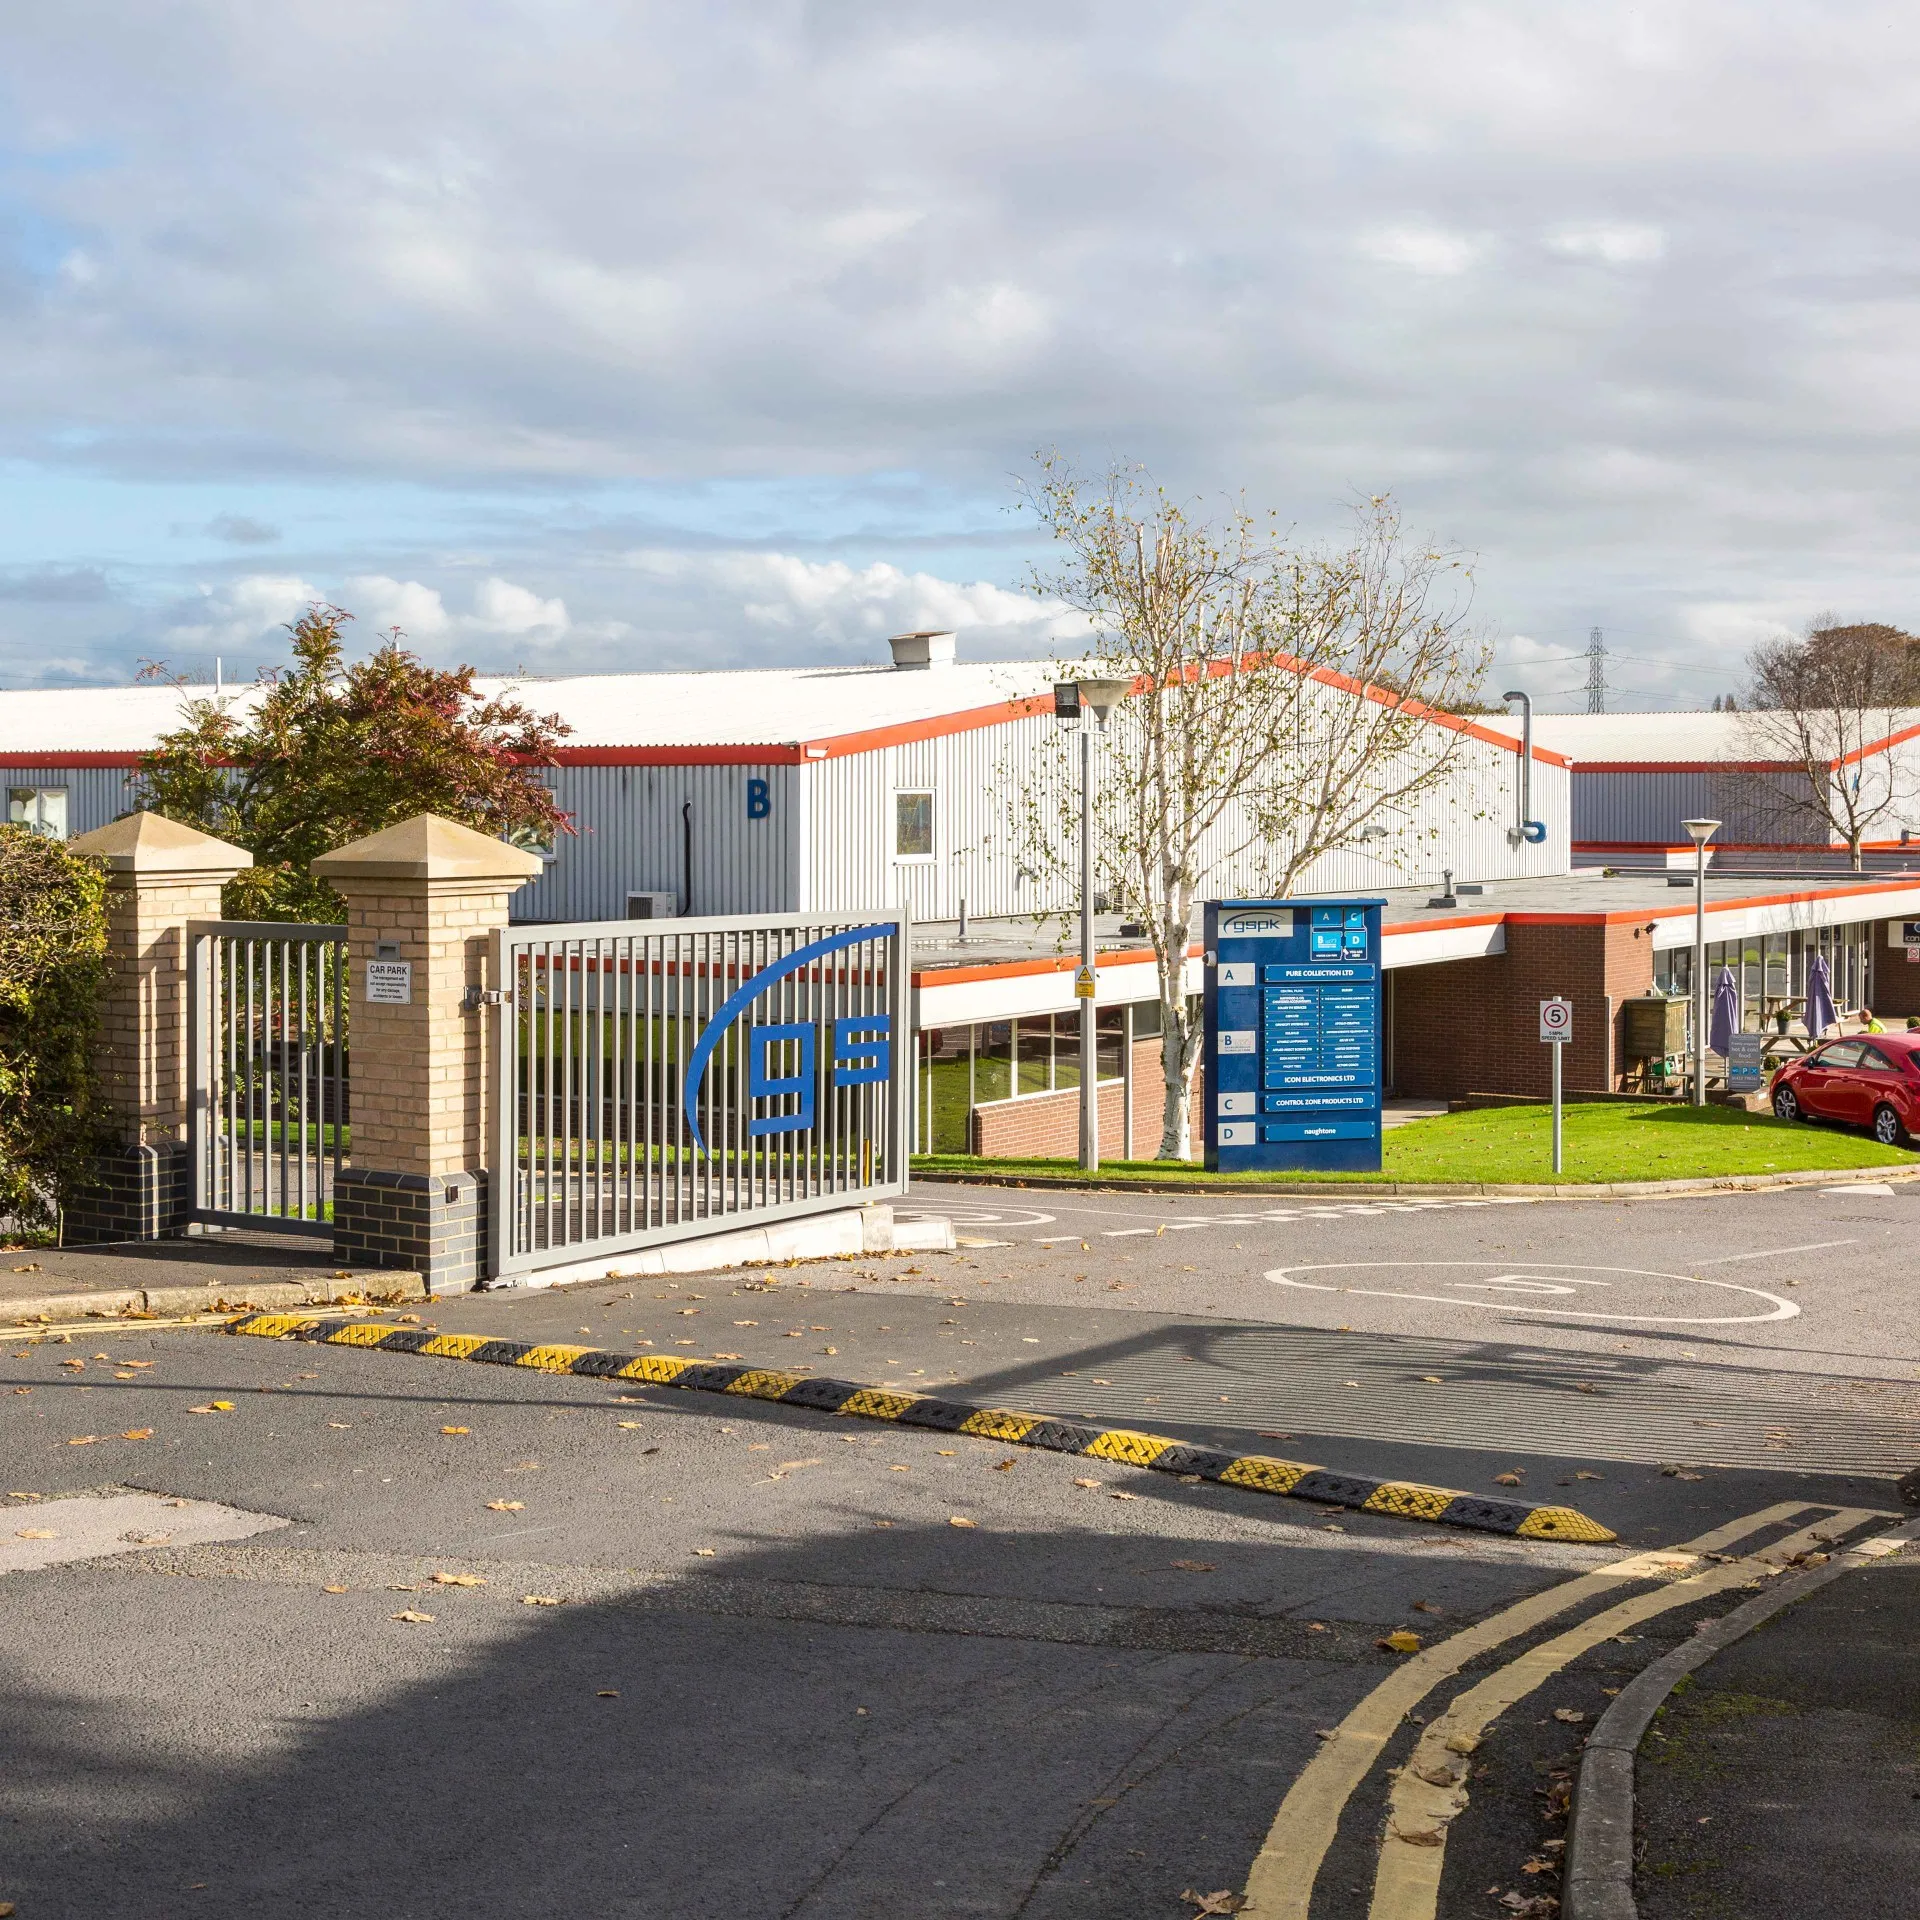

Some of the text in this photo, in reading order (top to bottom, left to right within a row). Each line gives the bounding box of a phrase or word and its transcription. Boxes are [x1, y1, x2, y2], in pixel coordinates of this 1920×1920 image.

[747, 779, 771, 819] B
[1322, 912, 1330, 921] A
[1350, 912, 1358, 921] C
[1233, 918, 1281, 934] gspk
[1317, 935, 1324, 944] B
[1352, 935, 1360, 945] D
[370, 964, 408, 975] CAR PARK
[1225, 969, 1234, 981] A
[1550, 1009, 1562, 1023] 5
[1224, 1034, 1232, 1046] B
[750, 1014, 890, 1137] gs
[1302, 1075, 1342, 1083] ELECTRONICS
[1224, 1099, 1233, 1110] C
[1224, 1128, 1234, 1139] D
[1304, 1128, 1337, 1136] naughtone
